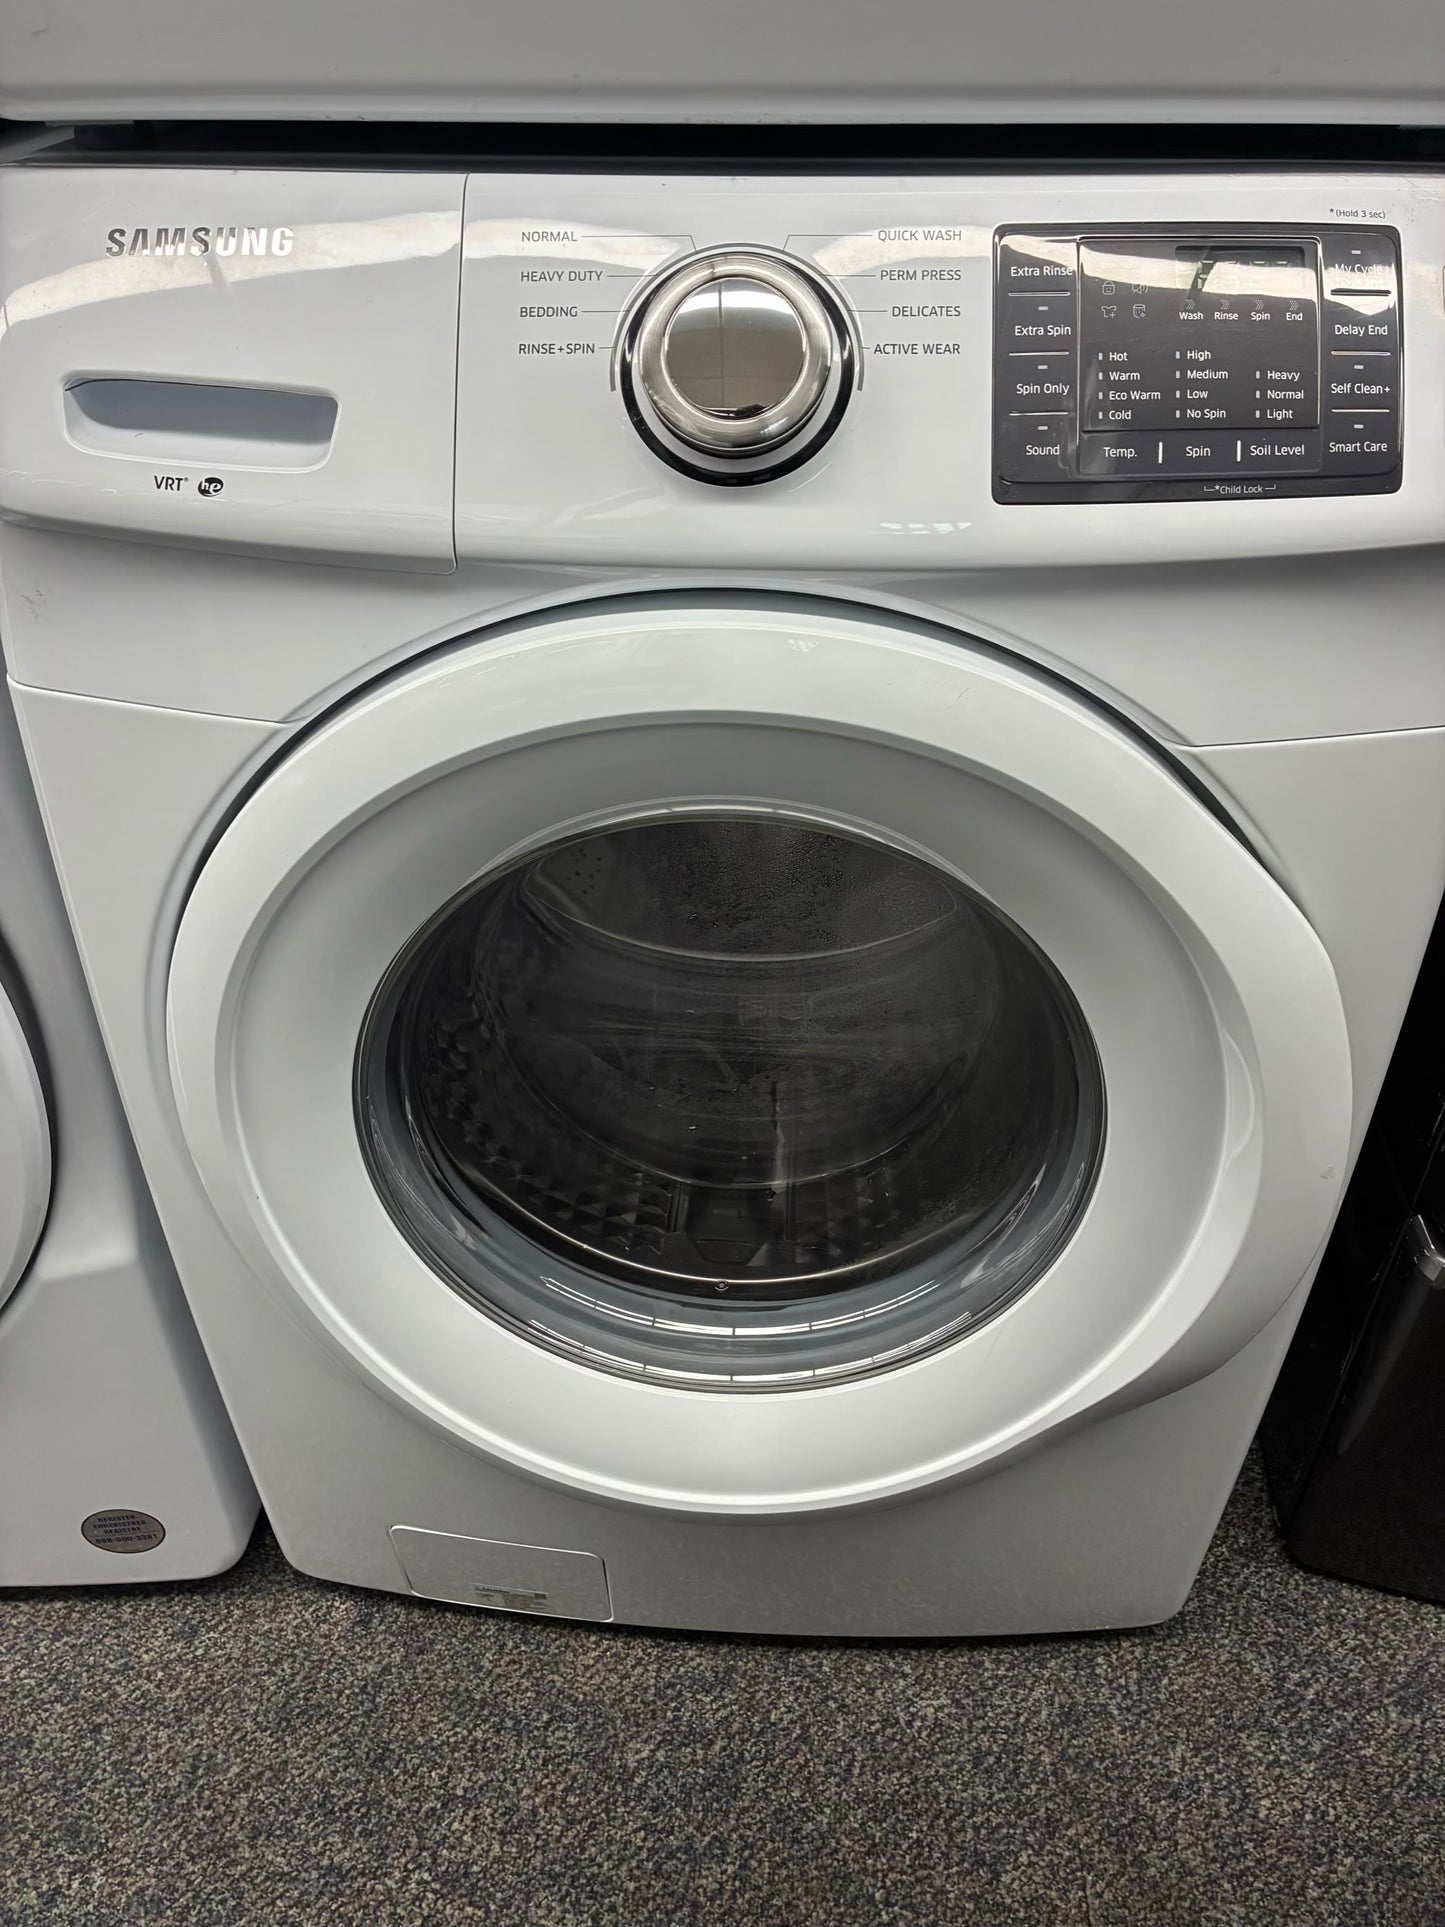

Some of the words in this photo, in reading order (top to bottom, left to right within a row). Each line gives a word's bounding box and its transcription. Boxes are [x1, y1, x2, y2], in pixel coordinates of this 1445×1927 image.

[1369, 210, 1386, 219] sec)
[105, 226, 295, 257] SAMSUNG
[521, 231, 578, 242] NORMAL
[878, 230, 918, 242] QUICK
[923, 230, 962, 241] WASH
[1010, 266, 1040, 277] Extra
[1043, 265, 1073, 276] Rinse
[1334, 263, 1352, 274] My
[1354, 264, 1383, 275] Cycle
[520, 271, 564, 282] HEAVY
[568, 270, 603, 281] DUTY
[880, 269, 917, 281] PERM
[921, 269, 961, 281] PRESS
[519, 306, 578, 317] BEDDING
[892, 306, 961, 317] DELICATES
[1179, 311, 1203, 320] Wash
[1214, 311, 1239, 320] Rinse
[1250, 311, 1270, 321] Spin
[1286, 312, 1303, 321] End
[1014, 325, 1044, 336] Extra
[1047, 325, 1071, 337] Spin
[1334, 324, 1365, 336] Delay
[1368, 325, 1388, 335] End
[518, 343, 595, 354] RINSE+SPIN
[873, 343, 918, 355] ACTIVE
[922, 343, 961, 355] WEAR
[1109, 352, 1128, 361] Hot
[1186, 350, 1211, 361] High
[1109, 371, 1140, 381] Warm
[1186, 369, 1229, 379] Medium
[1267, 370, 1300, 381] Heavy
[1016, 383, 1041, 395] Spin
[1043, 383, 1070, 395] Only
[1186, 389, 1208, 399] Low
[1267, 389, 1305, 399] Normal
[1330, 383, 1351, 394] Self
[1354, 383, 1391, 394] Clean+
[1109, 391, 1128, 400] Eco
[1130, 390, 1161, 400] Warm
[1108, 410, 1132, 420] Cold
[1186, 409, 1202, 418] No
[1204, 408, 1227, 420] Spin
[1267, 409, 1293, 420] Light
[1025, 444, 1060, 456] Sound
[1103, 446, 1138, 458] Temp.
[1185, 445, 1211, 458] Spin
[1250, 444, 1271, 456] Soil
[1274, 444, 1305, 455] Level
[1328, 442, 1361, 452] Smart
[1363, 441, 1388, 452] Care
[1243, 484, 1263, 494] Lock
